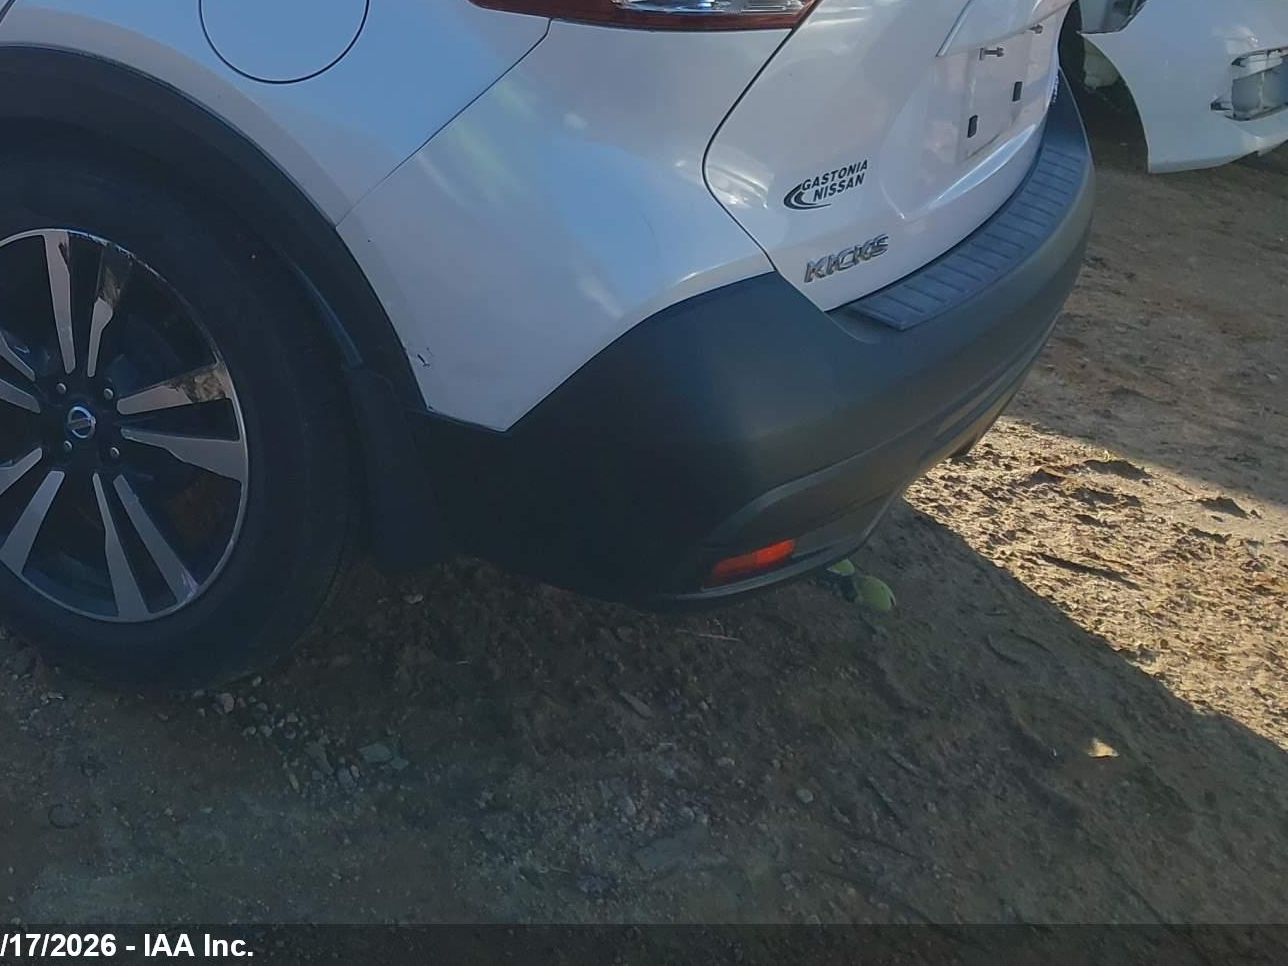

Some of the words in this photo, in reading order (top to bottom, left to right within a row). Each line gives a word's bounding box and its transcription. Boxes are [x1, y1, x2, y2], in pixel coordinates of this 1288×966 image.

[802, 159, 868, 191] GASTONIA
[813, 173, 865, 203] NISSAN
[804, 234, 888, 283] KICKS
